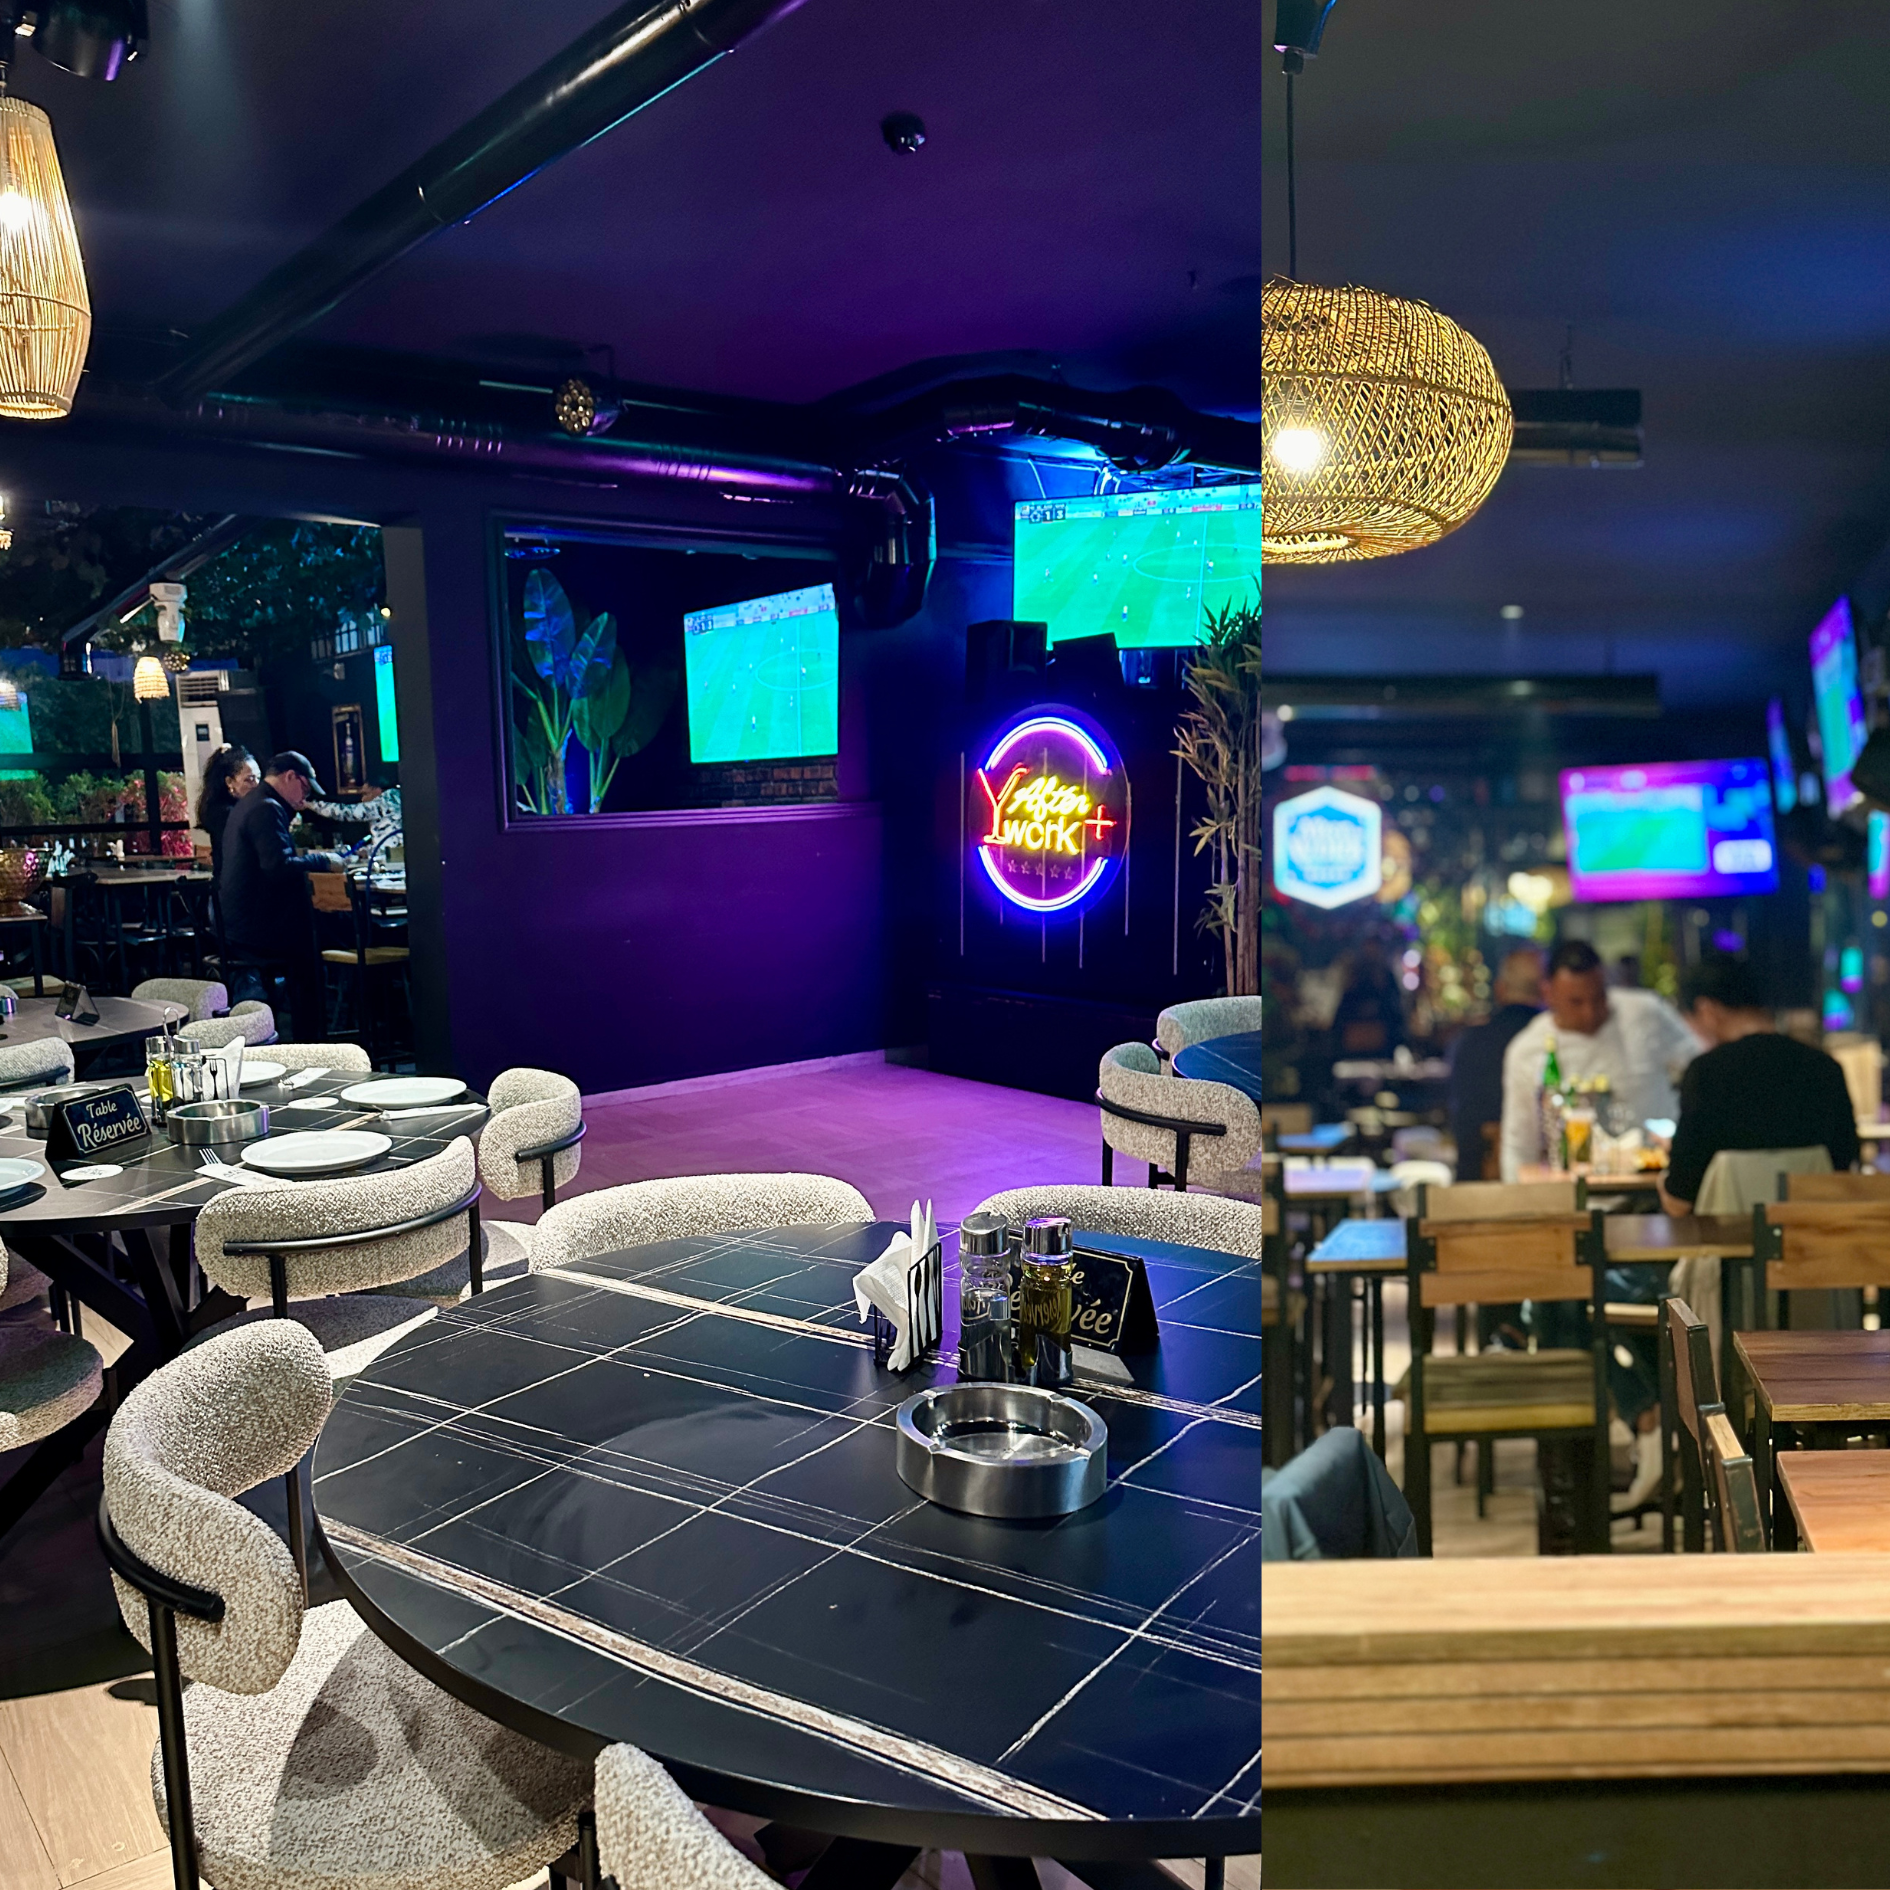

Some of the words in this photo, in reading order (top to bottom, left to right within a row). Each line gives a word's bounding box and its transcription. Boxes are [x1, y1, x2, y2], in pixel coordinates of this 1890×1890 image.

[1006, 775, 1092, 822] After
[1003, 815, 1083, 855] work
[86, 1100, 118, 1118] Table
[77, 1112, 142, 1148] Réservée
